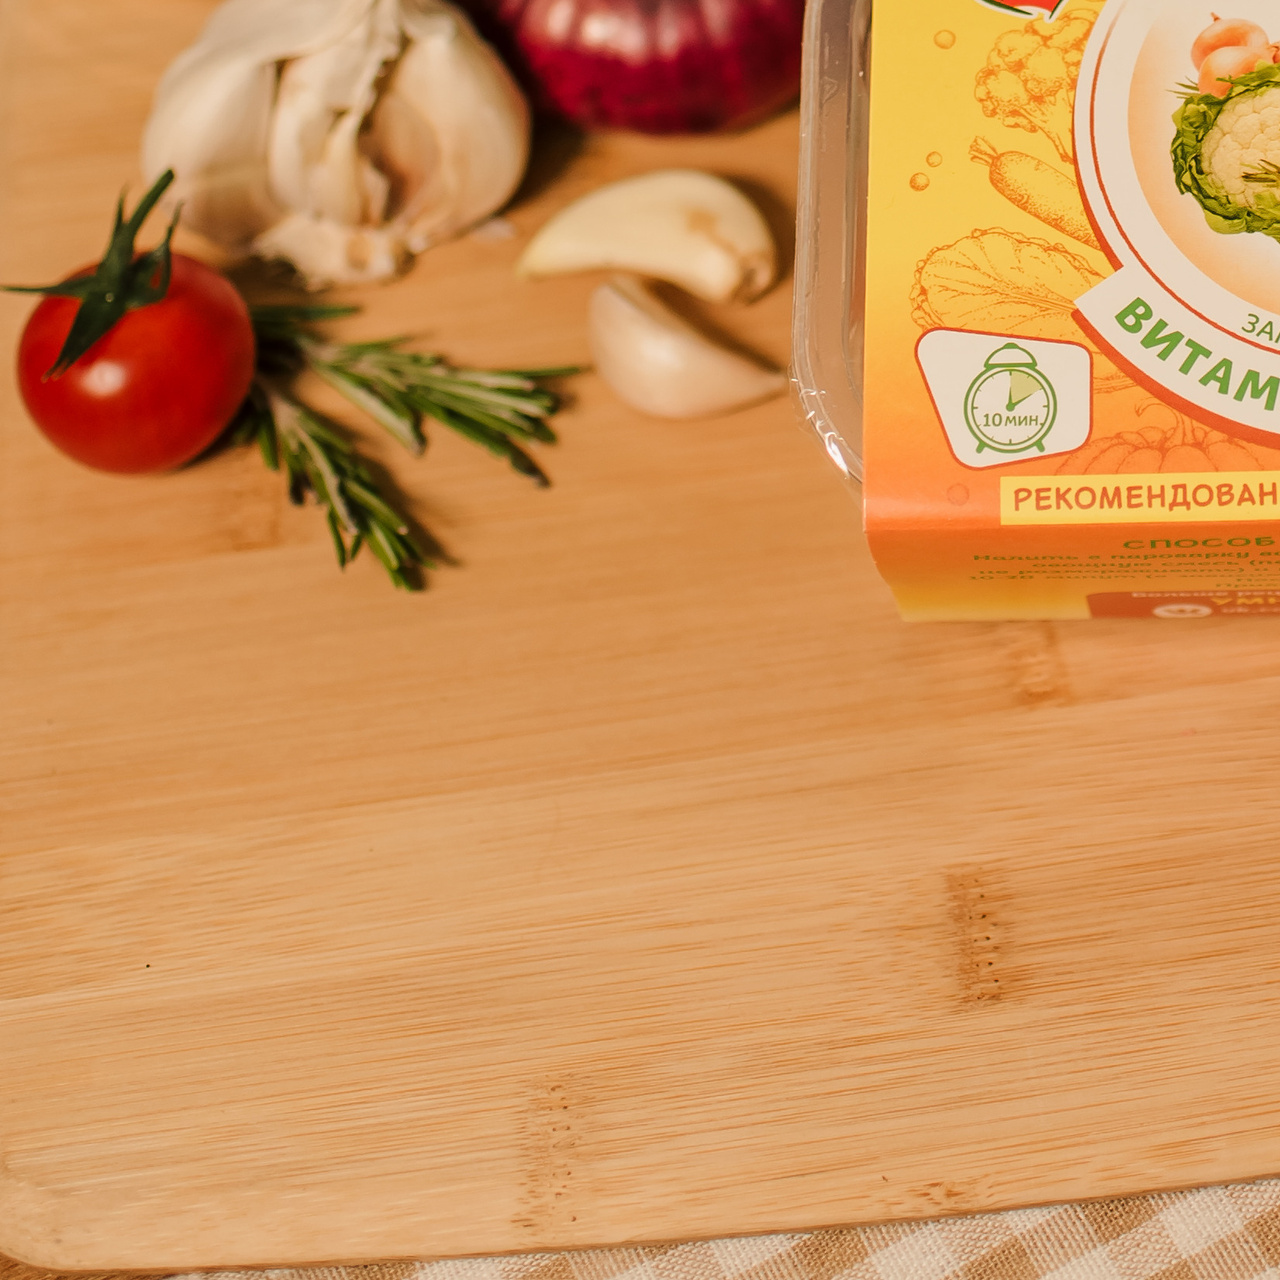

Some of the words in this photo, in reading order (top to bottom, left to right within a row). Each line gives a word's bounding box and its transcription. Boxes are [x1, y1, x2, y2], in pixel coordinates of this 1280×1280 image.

[983, 413, 1002, 427] 10
[1123, 536, 1275, 550] СПОСОБ
[1111, 551, 1249, 561] пароварку
